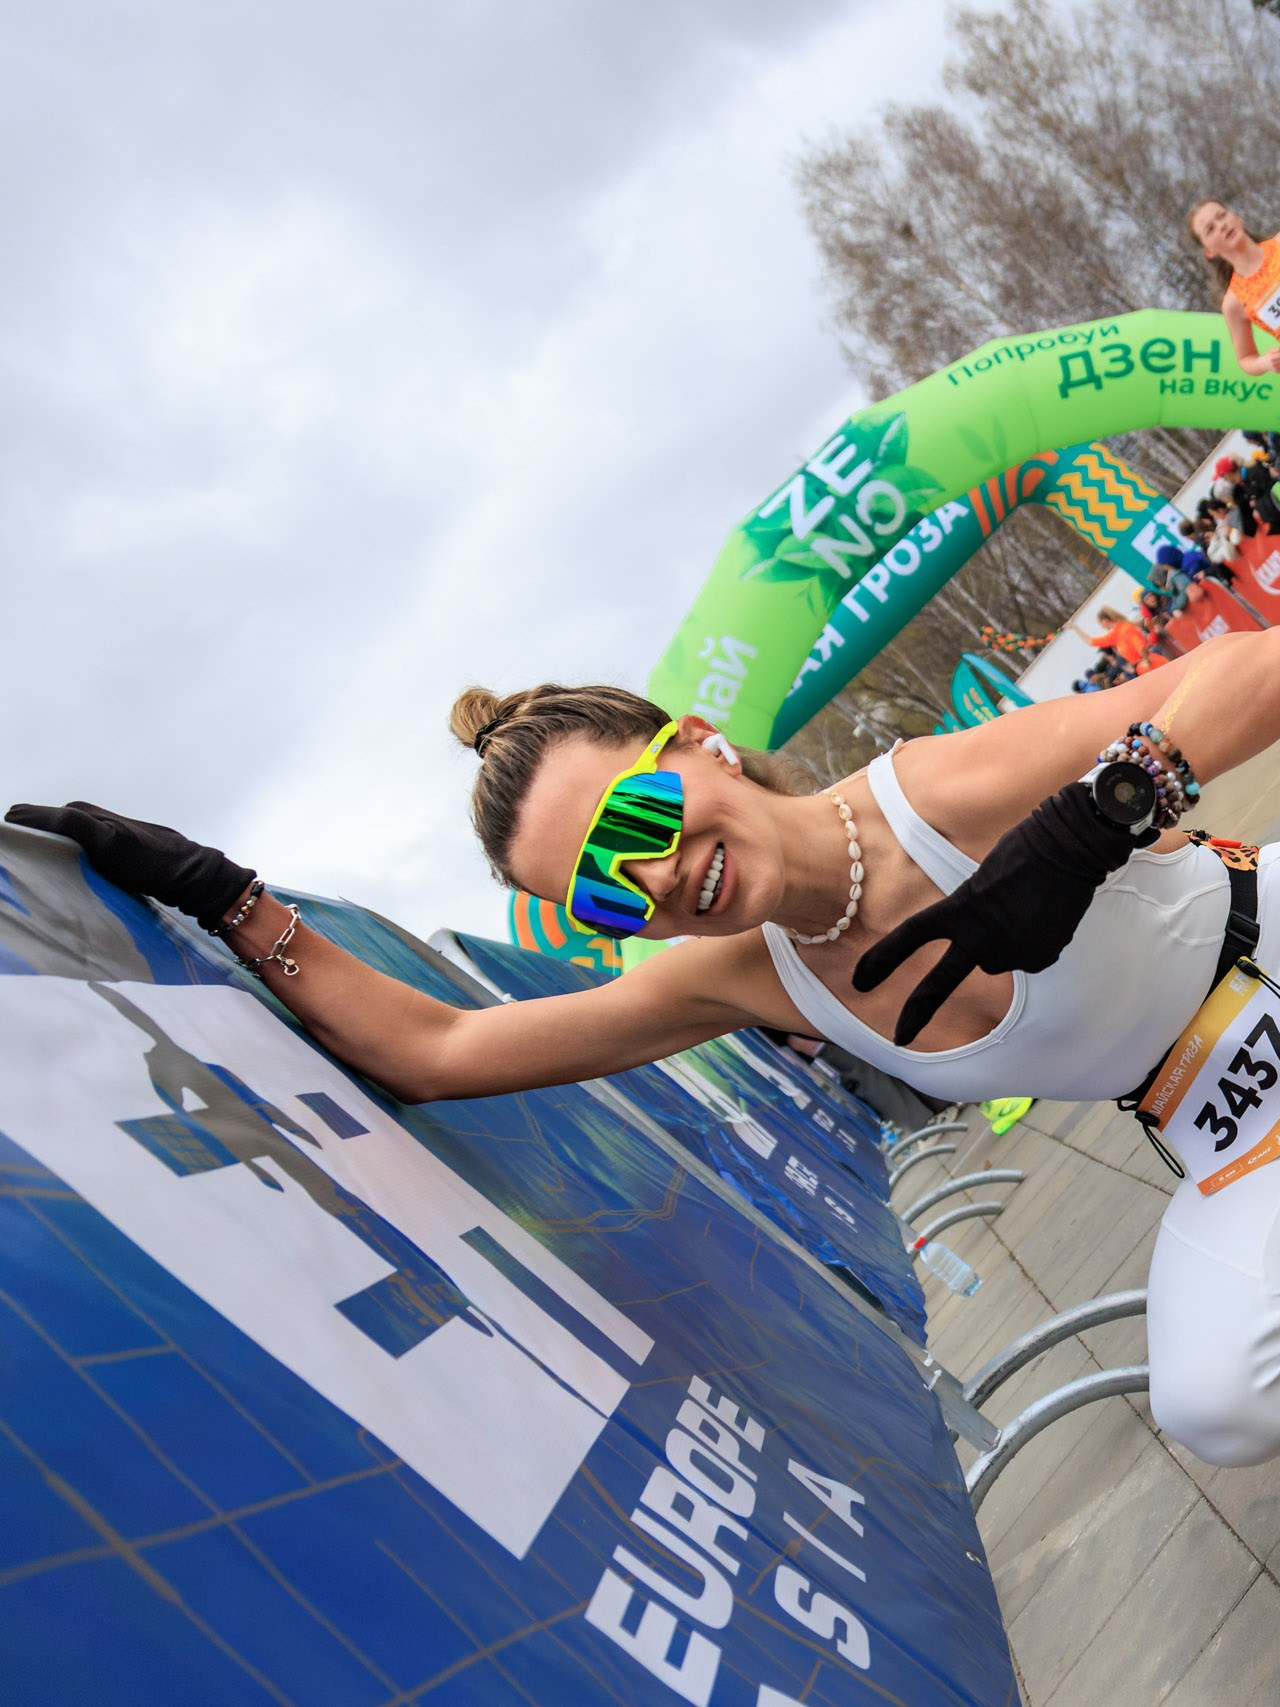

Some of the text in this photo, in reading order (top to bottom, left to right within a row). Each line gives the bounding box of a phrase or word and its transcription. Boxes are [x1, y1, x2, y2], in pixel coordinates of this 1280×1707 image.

[946, 324, 1121, 386] Попробуй
[1159, 377, 1274, 403] на вкус
[840, 499, 969, 623] ГРОЗА
[1151, 1065, 1187, 1117] МАЙСКАЯ
[584, 1374, 766, 1707] EUROPE
[757, 1457, 871, 1707] SIA
